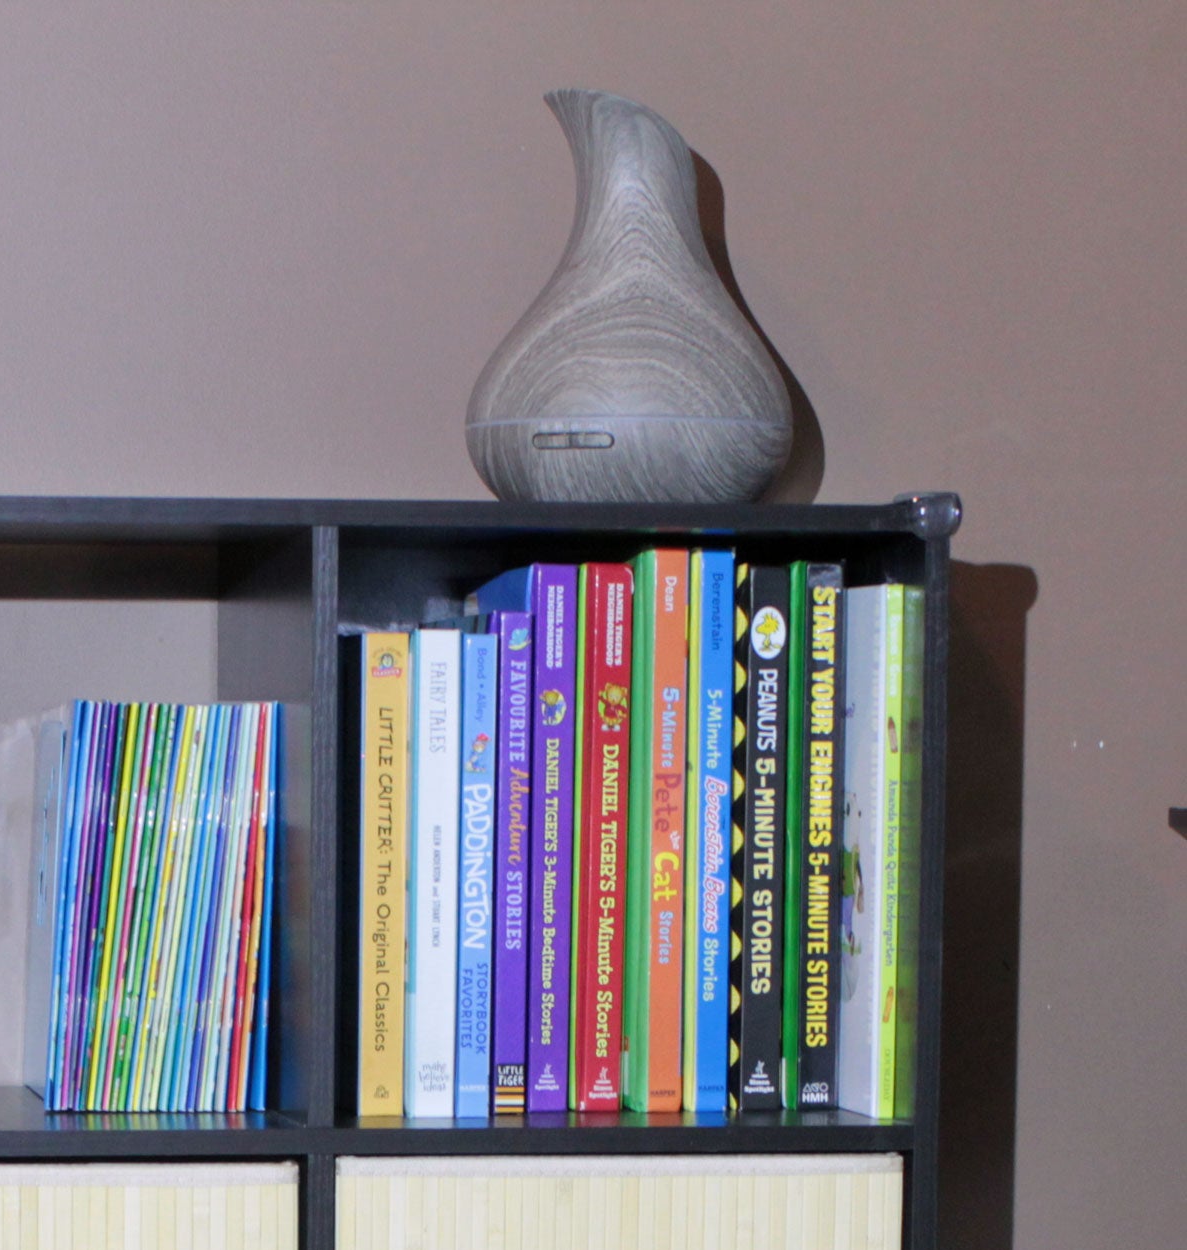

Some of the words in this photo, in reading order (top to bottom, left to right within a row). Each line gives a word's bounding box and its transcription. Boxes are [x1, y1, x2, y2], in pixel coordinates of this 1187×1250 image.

[546, 585, 556, 669] NEIGHBORHOOD
[555, 585, 564, 625] DANIEL
[606, 583, 616, 668] NEIGHBORHOOD
[615, 583, 625, 623] DANIEL
[665, 576, 678, 612] Dean
[712, 572, 725, 651] Berenstain
[811, 586, 836, 664] START
[476, 647, 488, 679] Bond
[555, 627, 564, 668] TIGER'S
[614, 626, 624, 666] TIGER'S
[429, 661, 447, 705] FAIRY
[474, 692, 487, 723] Alley
[510, 660, 527, 762] FAVOURITE
[757, 668, 778, 751] PEANUTS
[810, 668, 835, 735] YOUR
[378, 706, 393, 767] LITTLE
[429, 708, 447, 754] TALES
[661, 687, 681, 768] 5-Minute
[705, 689, 724, 769] 5-Minute
[545, 738, 559, 793] DANIEL
[602, 744, 620, 817] DANIEL
[808, 740, 833, 847] ENGINES
[507, 767, 531, 865] Adventure
[544, 797, 559, 852] TIGER'S
[655, 772, 682, 832] Pete
[704, 775, 729, 874] Berenstain
[753, 757, 776, 880] 5-MINUTE
[887, 779, 898, 822] Amanda
[600, 821, 618, 892] TIGER'S
[669, 831, 682, 850] the
[887, 825, 898, 857] Panda
[377, 860, 391, 896] The
[506, 870, 523, 950] STORIES
[543, 856, 557, 924] 3-Minute
[654, 851, 680, 902] Cat
[702, 876, 726, 933] Bears
[806, 852, 831, 955] 5-MINUTE
[372, 903, 391, 974] Original
[542, 927, 556, 989] Bedtime
[598, 897, 615, 985] 5-Minute
[658, 910, 675, 964] Stories
[751, 889, 773, 995] STORIES
[883, 894, 896, 967] Kindergarten
[702, 937, 719, 1002] Stories
[374, 981, 390, 1052] Classics
[461, 968, 474, 1049] FAVORITES
[475, 962, 489, 1055] STORYBOOK
[541, 993, 554, 1045] Stories
[595, 990, 613, 1057] Stories
[805, 960, 829, 1048] STORIES
[802, 1092, 828, 1103] HMH
